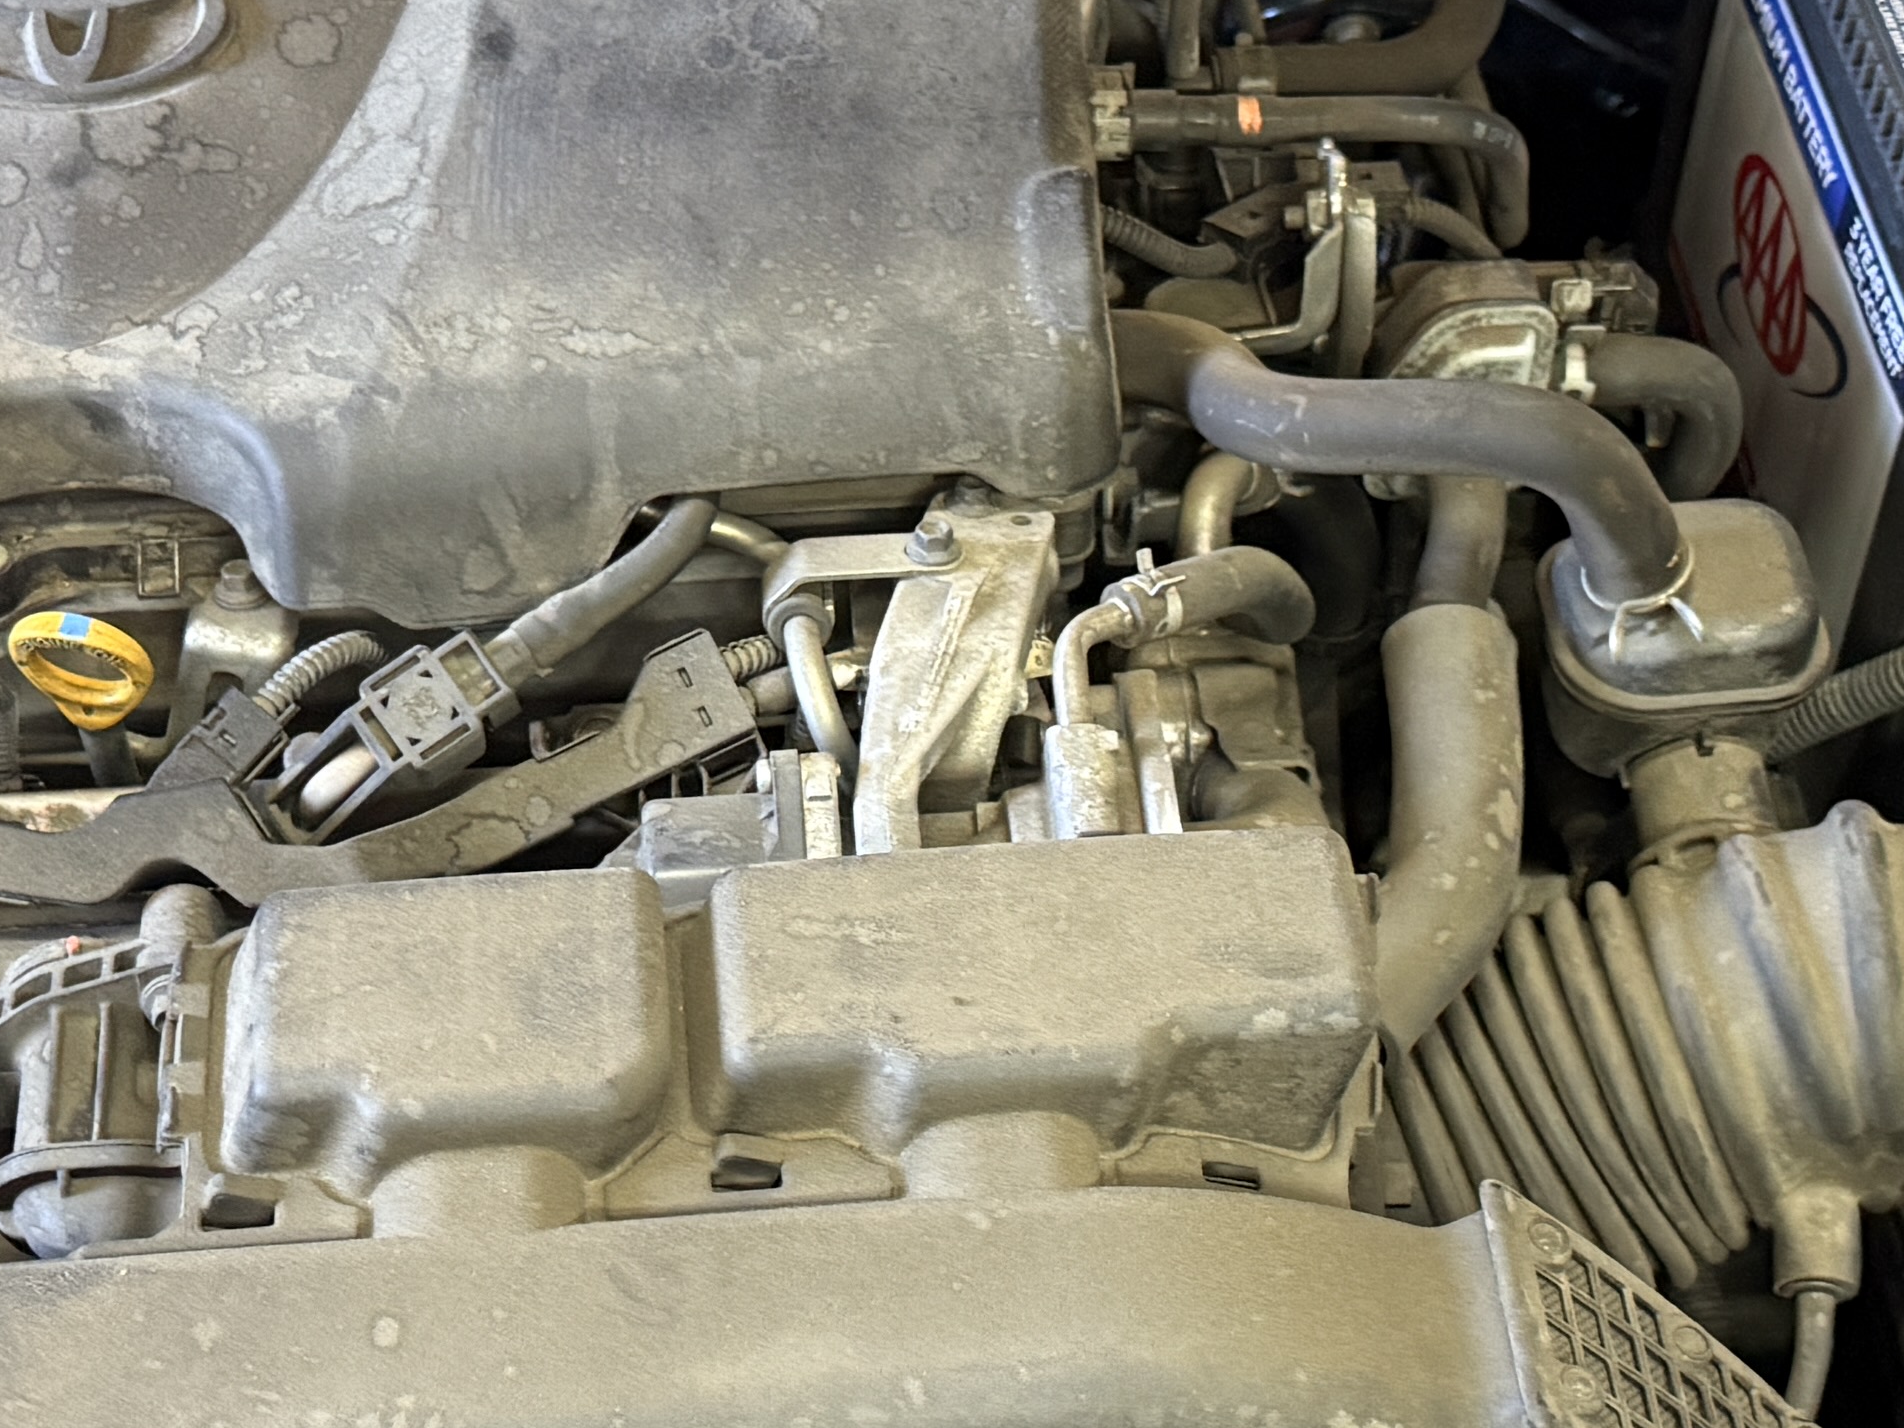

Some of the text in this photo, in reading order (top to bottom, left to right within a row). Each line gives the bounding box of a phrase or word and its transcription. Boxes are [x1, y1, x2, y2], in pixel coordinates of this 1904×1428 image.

[1784, 72, 1839, 189] BATTERY
[1735, 154, 1806, 377] AAA
[1849, 217, 1866, 240] 3
[1858, 236, 1887, 301] YEAR
